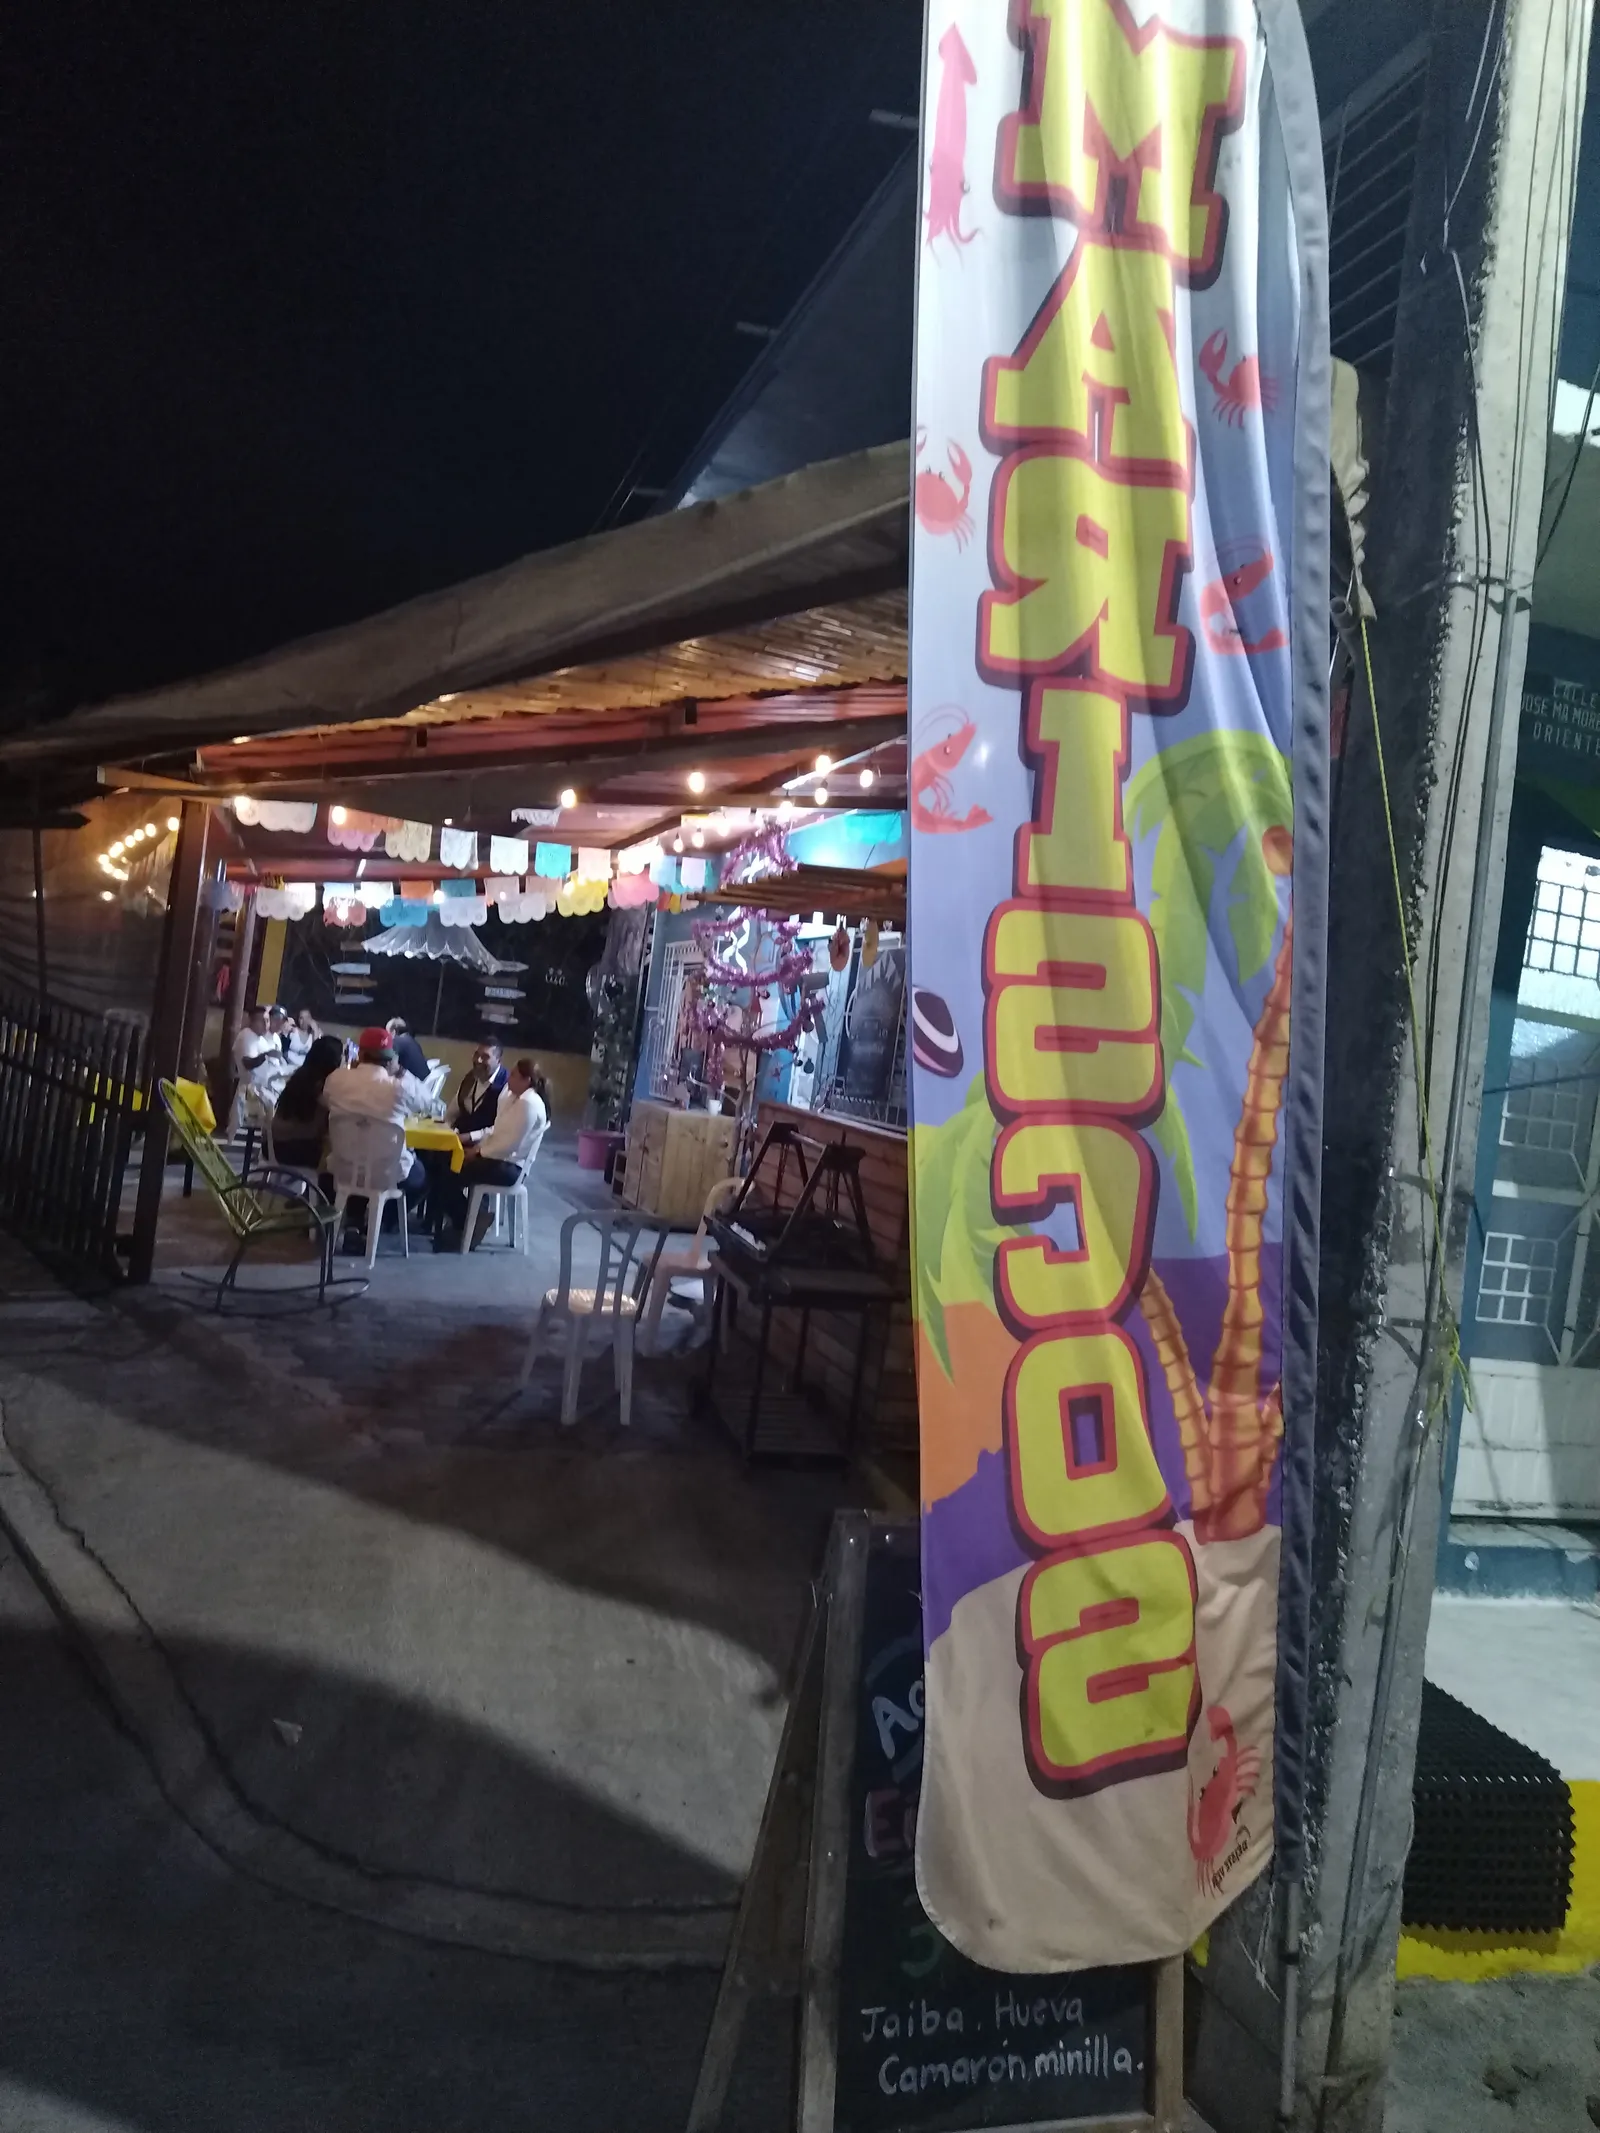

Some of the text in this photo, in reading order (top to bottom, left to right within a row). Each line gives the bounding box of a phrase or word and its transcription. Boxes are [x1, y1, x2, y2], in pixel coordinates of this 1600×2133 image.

[1552, 683, 1598, 709] CALLE
[1533, 720, 1600, 757] ORIENTE
[995, 1989, 1085, 2028] Hueva
